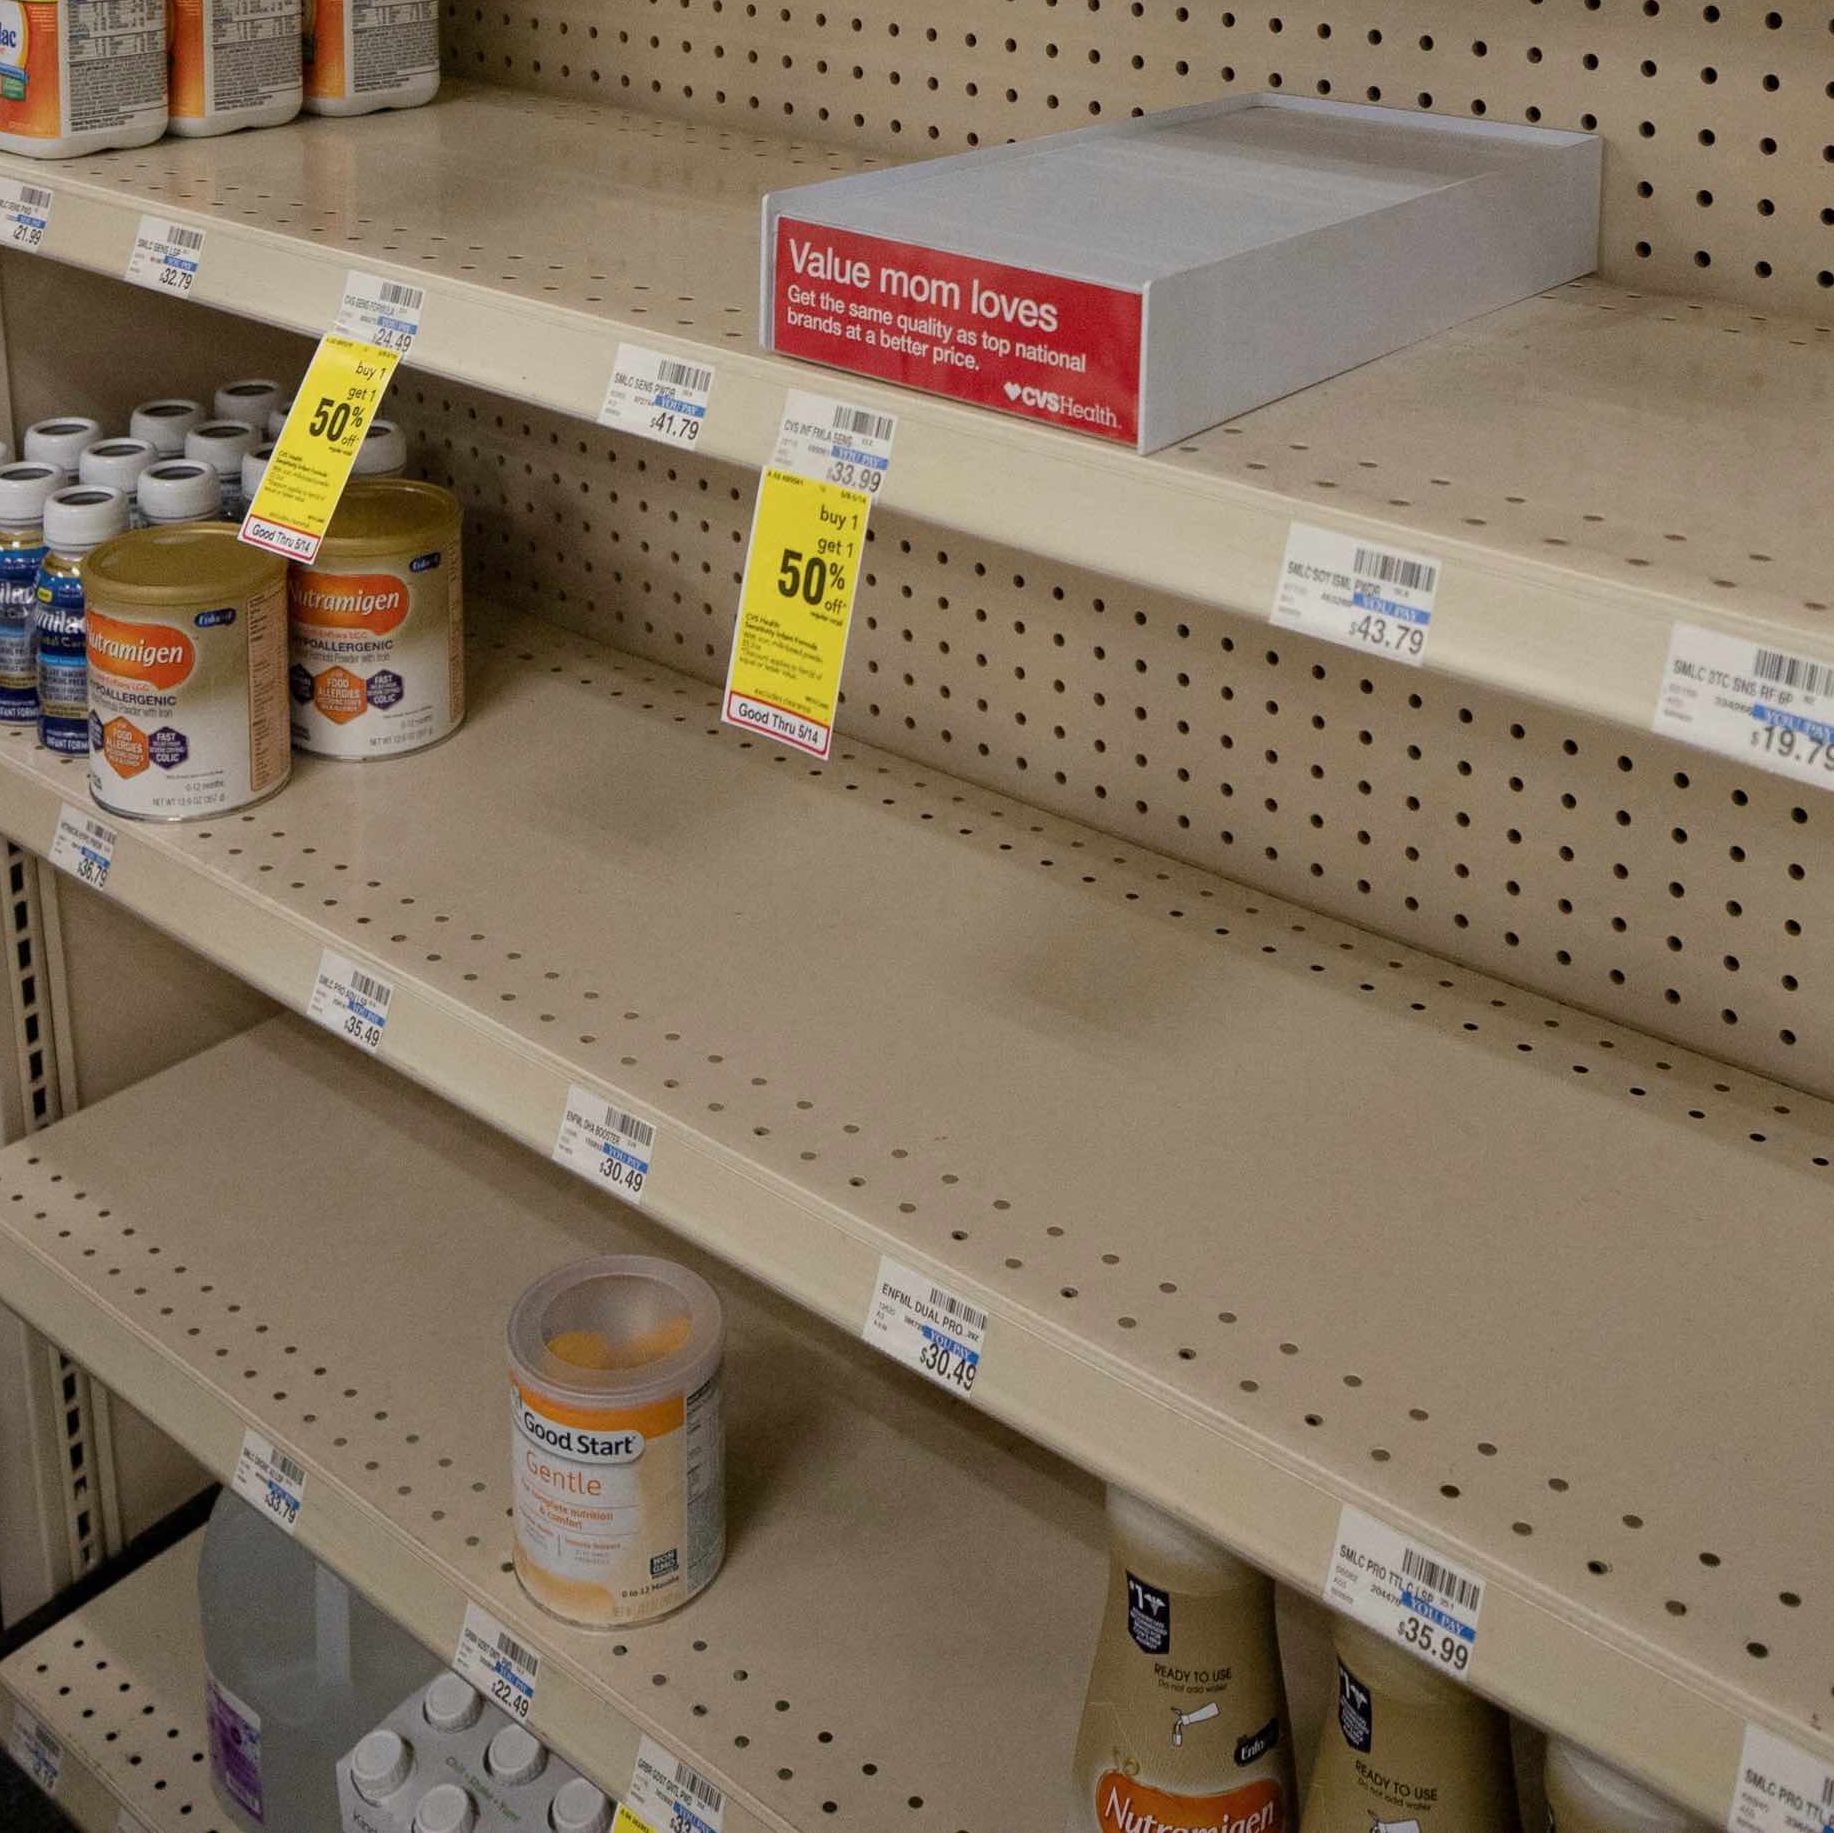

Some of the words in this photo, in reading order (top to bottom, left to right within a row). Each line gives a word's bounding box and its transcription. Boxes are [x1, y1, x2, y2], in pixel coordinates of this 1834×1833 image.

[788, 237, 873, 289] Value
[879, 266, 962, 312] mom
[970, 276, 1060, 334] loves
[786, 282, 818, 310] Get
[818, 289, 846, 316] the
[848, 302, 894, 327] same
[896, 310, 954, 345] quality
[956, 326, 979, 347] as
[980, 330, 1012, 358] top
[1013, 340, 1088, 373] national
[786, 307, 843, 338] brands
[845, 320, 863, 342] at
[865, 328, 878, 346] a
[879, 327, 930, 359] better
[932, 344, 982, 373] price.
[648, 412, 700, 442] $41.79
[825, 460, 883, 494] $33.99
[818, 503, 850, 532] buy
[850, 513, 860, 531] 1
[816, 536, 846, 561] get
[846, 540, 855, 558] 1
[1348, 614, 1425, 655] $43.79
[737, 701, 770, 726] Good
[772, 712, 797, 735] Thru
[797, 721, 819, 745] 5/14
[881, 1282, 913, 1310] ENFML
[914, 1300, 941, 1325] DUAL
[941, 1315, 965, 1337] PRO
[918, 1342, 978, 1392] $30.49
[523, 1410, 574, 1454] Good
[576, 1434, 635, 1457] Start
[525, 1447, 603, 1497] Gentle
[1396, 1614, 1471, 1672] $35.99
